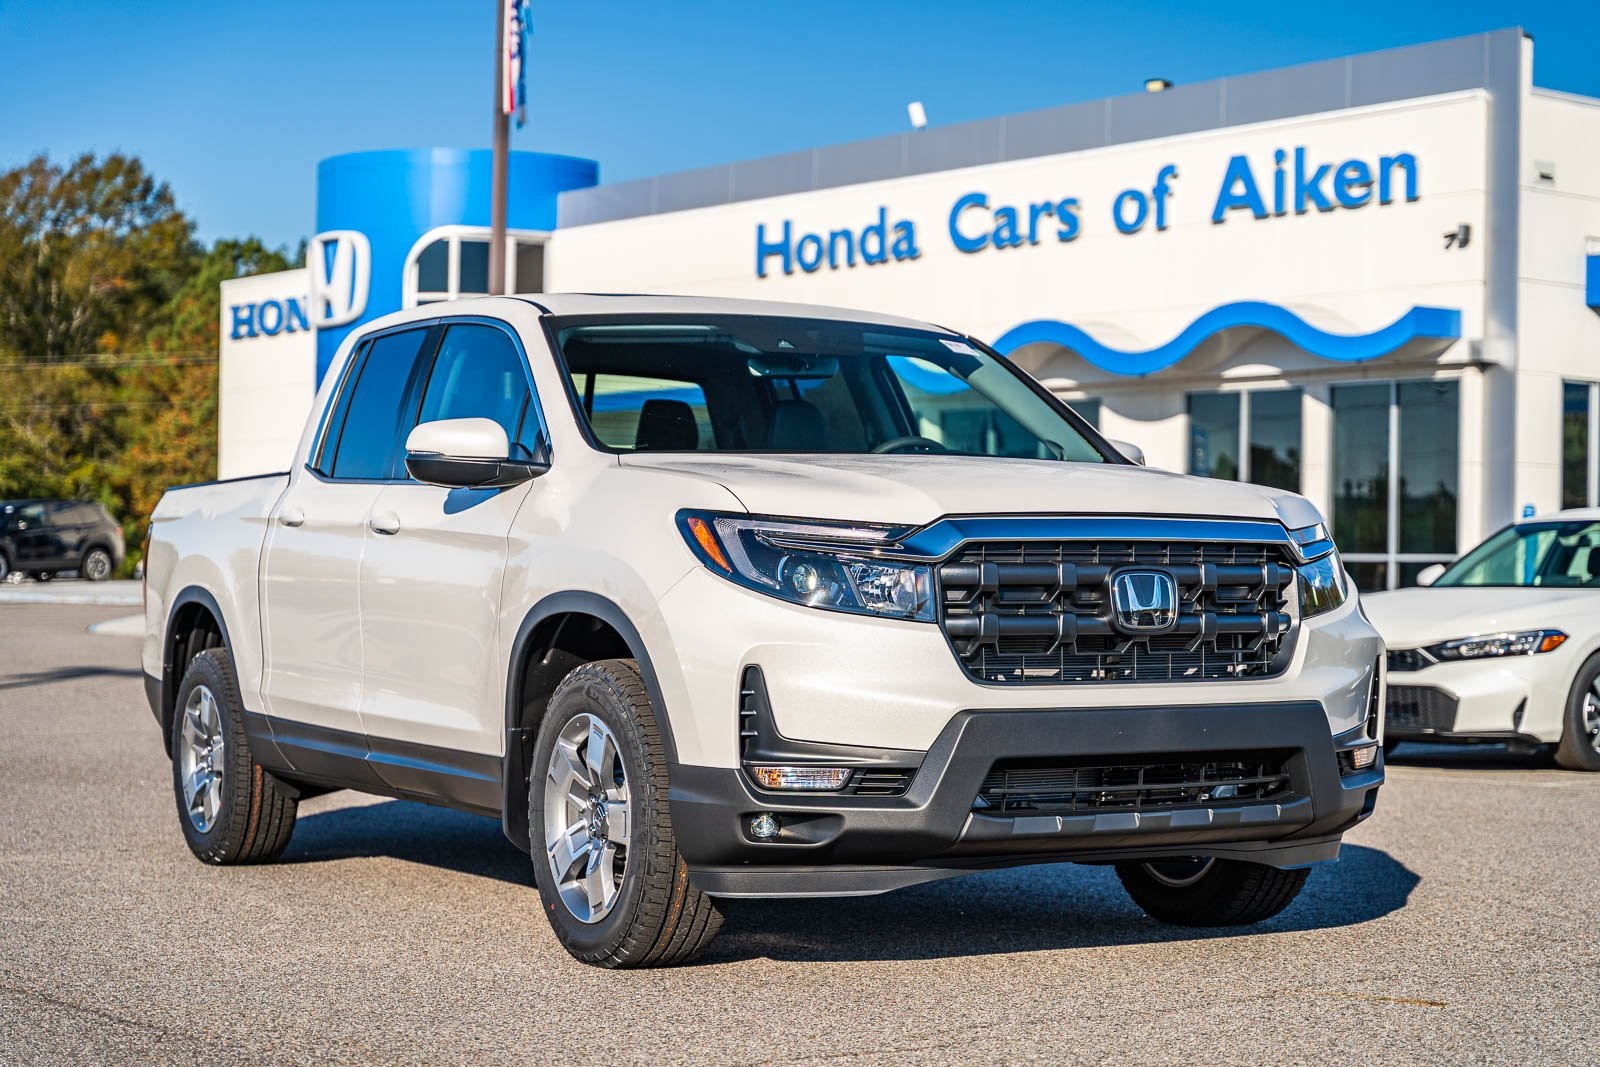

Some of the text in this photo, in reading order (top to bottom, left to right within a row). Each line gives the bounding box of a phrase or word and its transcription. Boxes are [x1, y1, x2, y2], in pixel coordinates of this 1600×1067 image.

[755, 146, 1420, 277] Honda Cars of Aiken
